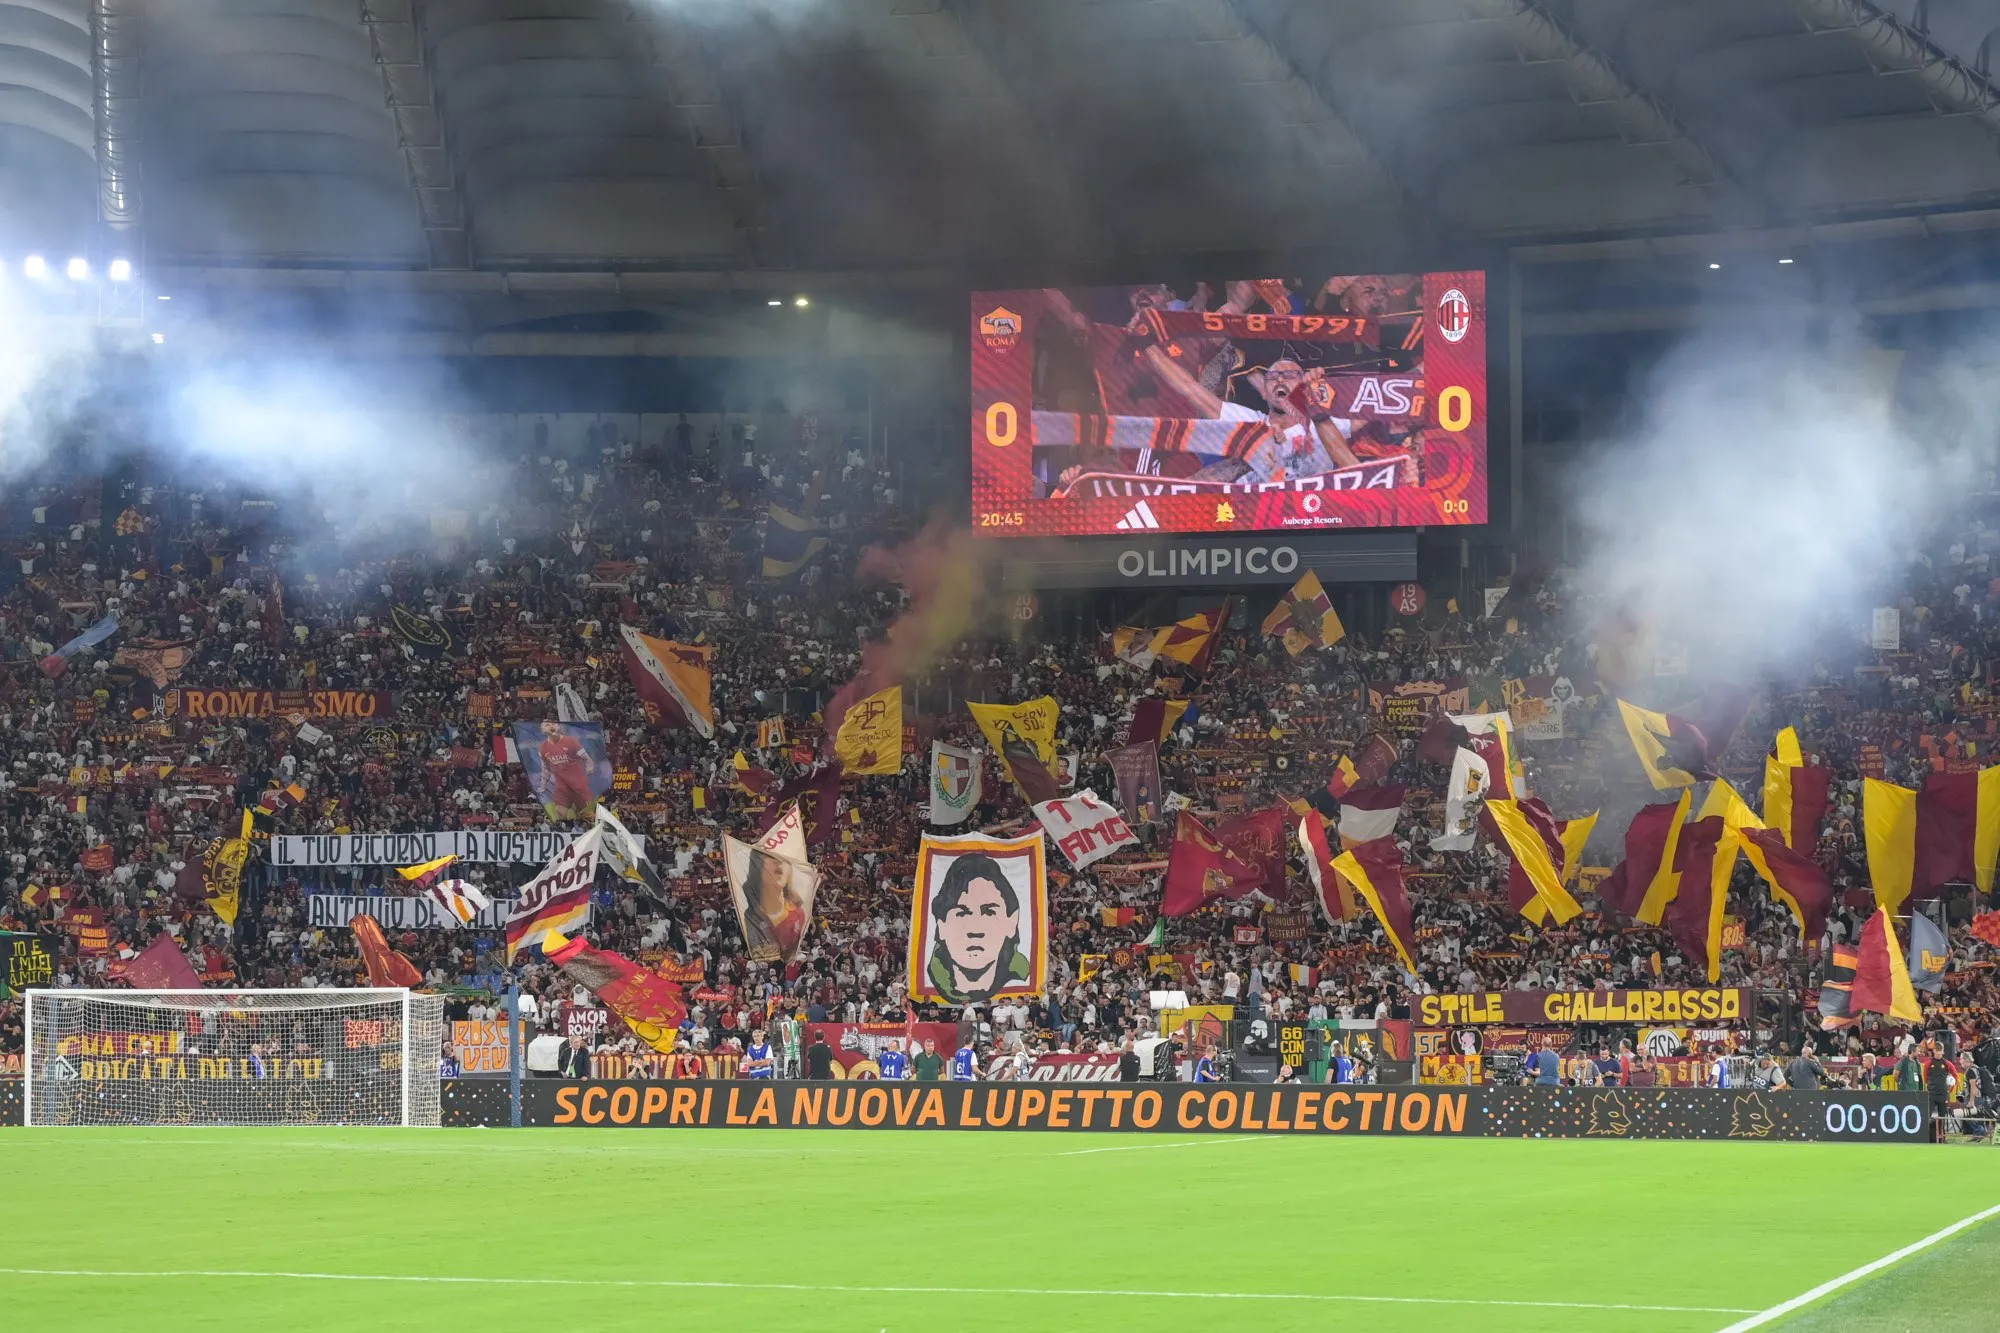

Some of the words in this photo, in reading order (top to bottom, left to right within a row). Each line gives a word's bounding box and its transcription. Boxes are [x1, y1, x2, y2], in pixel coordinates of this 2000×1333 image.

[1444, 291, 1464, 301] ACM
[1203, 311, 1224, 331] 5
[1247, 314, 1267, 332] 8
[1290, 317, 1366, 336] 1991
[986, 337, 1015, 347] ROMA
[1438, 385, 1472, 432] 0
[986, 401, 1018, 447] 0
[1443, 499, 1469, 513] 0:0
[980, 512, 1023, 527] 20:45
[1282, 517, 1313, 526] Auberge
[1314, 516, 1343, 524] Resorts
[1117, 546, 1299, 577] OLIMPICO
[1400, 584, 1416, 598] 19
[1400, 598, 1418, 612] AS
[1012, 606, 1033, 621] AD
[186, 690, 376, 719] ROMASMO
[1528, 723, 1560, 734] ONORE
[302, 836, 342, 864] TUO
[454, 832, 478, 861] LA
[414, 898, 442, 929] DE
[81, 928, 107, 938] ANDREA
[1722, 926, 1744, 947] 80s
[13, 942, 26, 957] IO
[31, 939, 43, 956] E
[80, 939, 108, 948] PRESENTE
[9, 957, 15, 972] I
[20, 955, 52, 972] MIEI
[568, 1009, 608, 1025] AMOR
[1281, 1027, 1303, 1040] 66
[1280, 1040, 1304, 1054] CON
[1281, 1054, 1303, 1067] NOI
[442, 1065, 453, 1076] 23
[884, 1065, 895, 1076] 41
[553, 1087, 713, 1125] SCOPRI
[726, 1087, 778, 1125] LA
[791, 1087, 946, 1126] NUOVA
[960, 1088, 1162, 1129] LUPETTO
[1177, 1090, 1468, 1132] COLLECTION
[1825, 1103, 1921, 1134] 00:00
